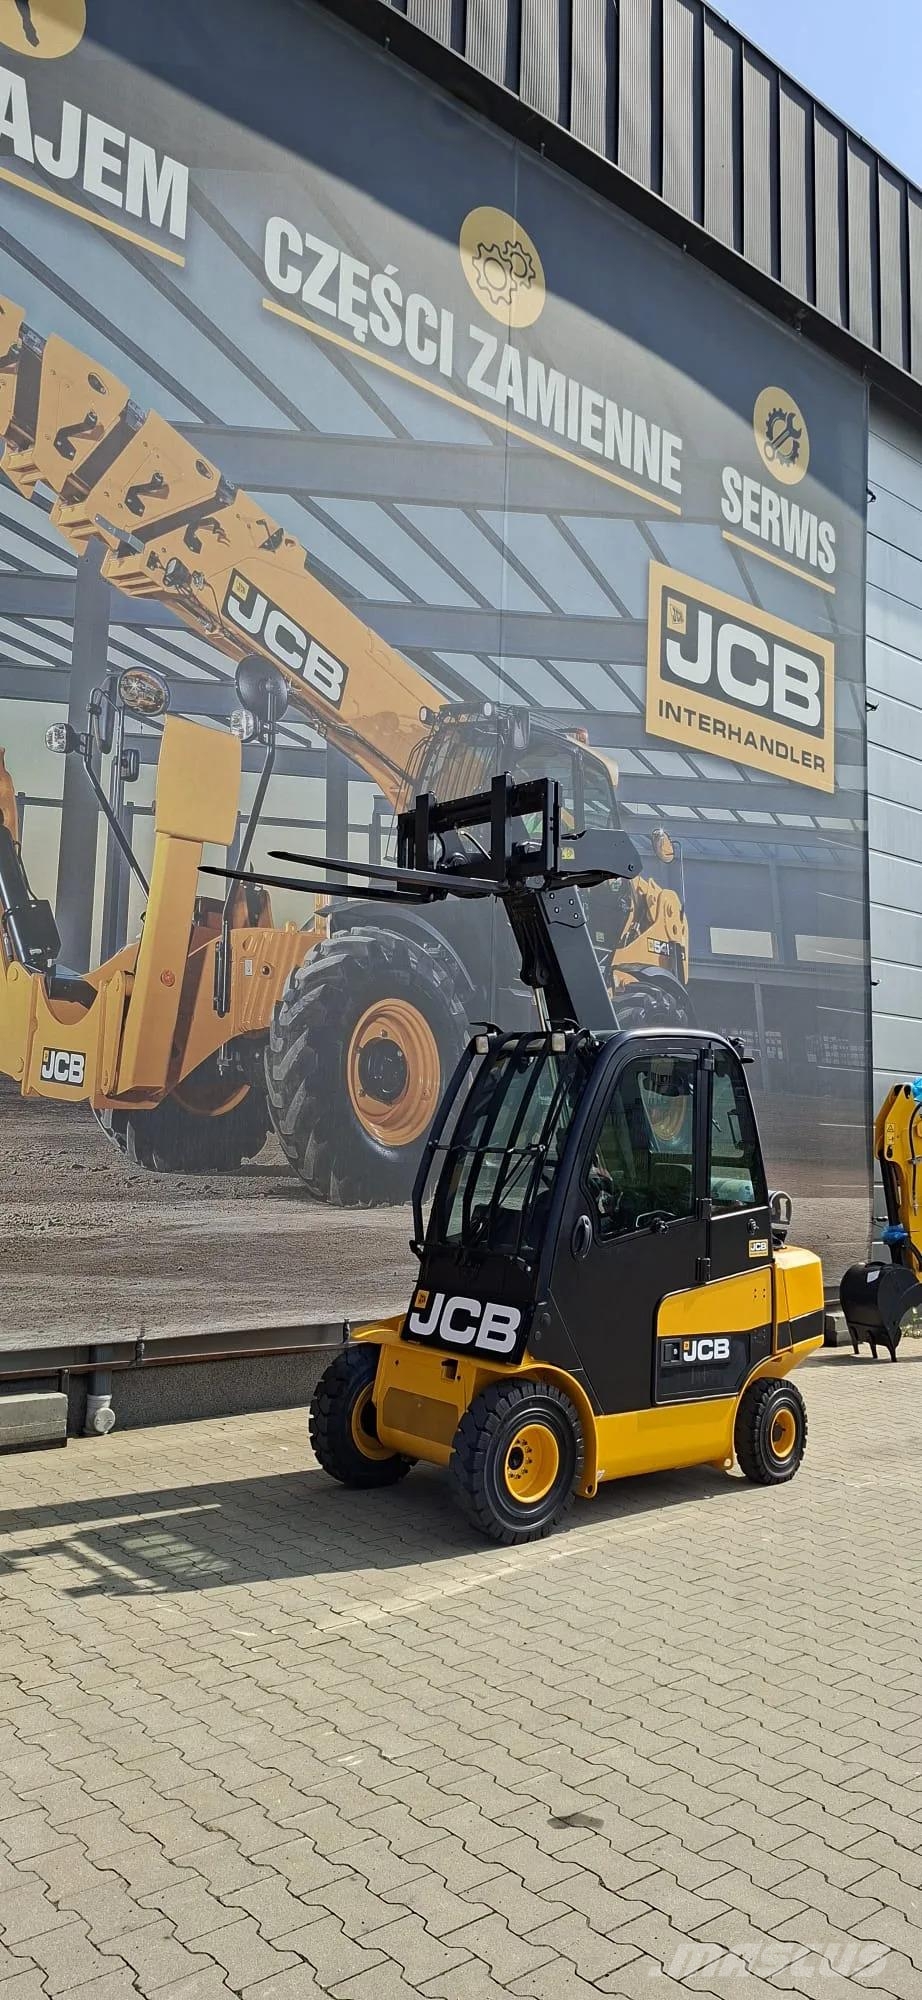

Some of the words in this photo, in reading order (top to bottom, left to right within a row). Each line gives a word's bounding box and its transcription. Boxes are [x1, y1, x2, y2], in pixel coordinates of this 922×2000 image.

[264, 217, 455, 377] CZĘŚCI
[467, 324, 683, 495] ZAMIENNE
[720, 466, 836, 575] SERWIS
[227, 593, 344, 701] JCB
[666, 610, 821, 727] JCB
[658, 699, 826, 773] INTERHANDLER
[42, 1050, 84, 1084] JCB
[409, 1292, 521, 1353] JCB
[683, 1338, 730, 1362] JCB
